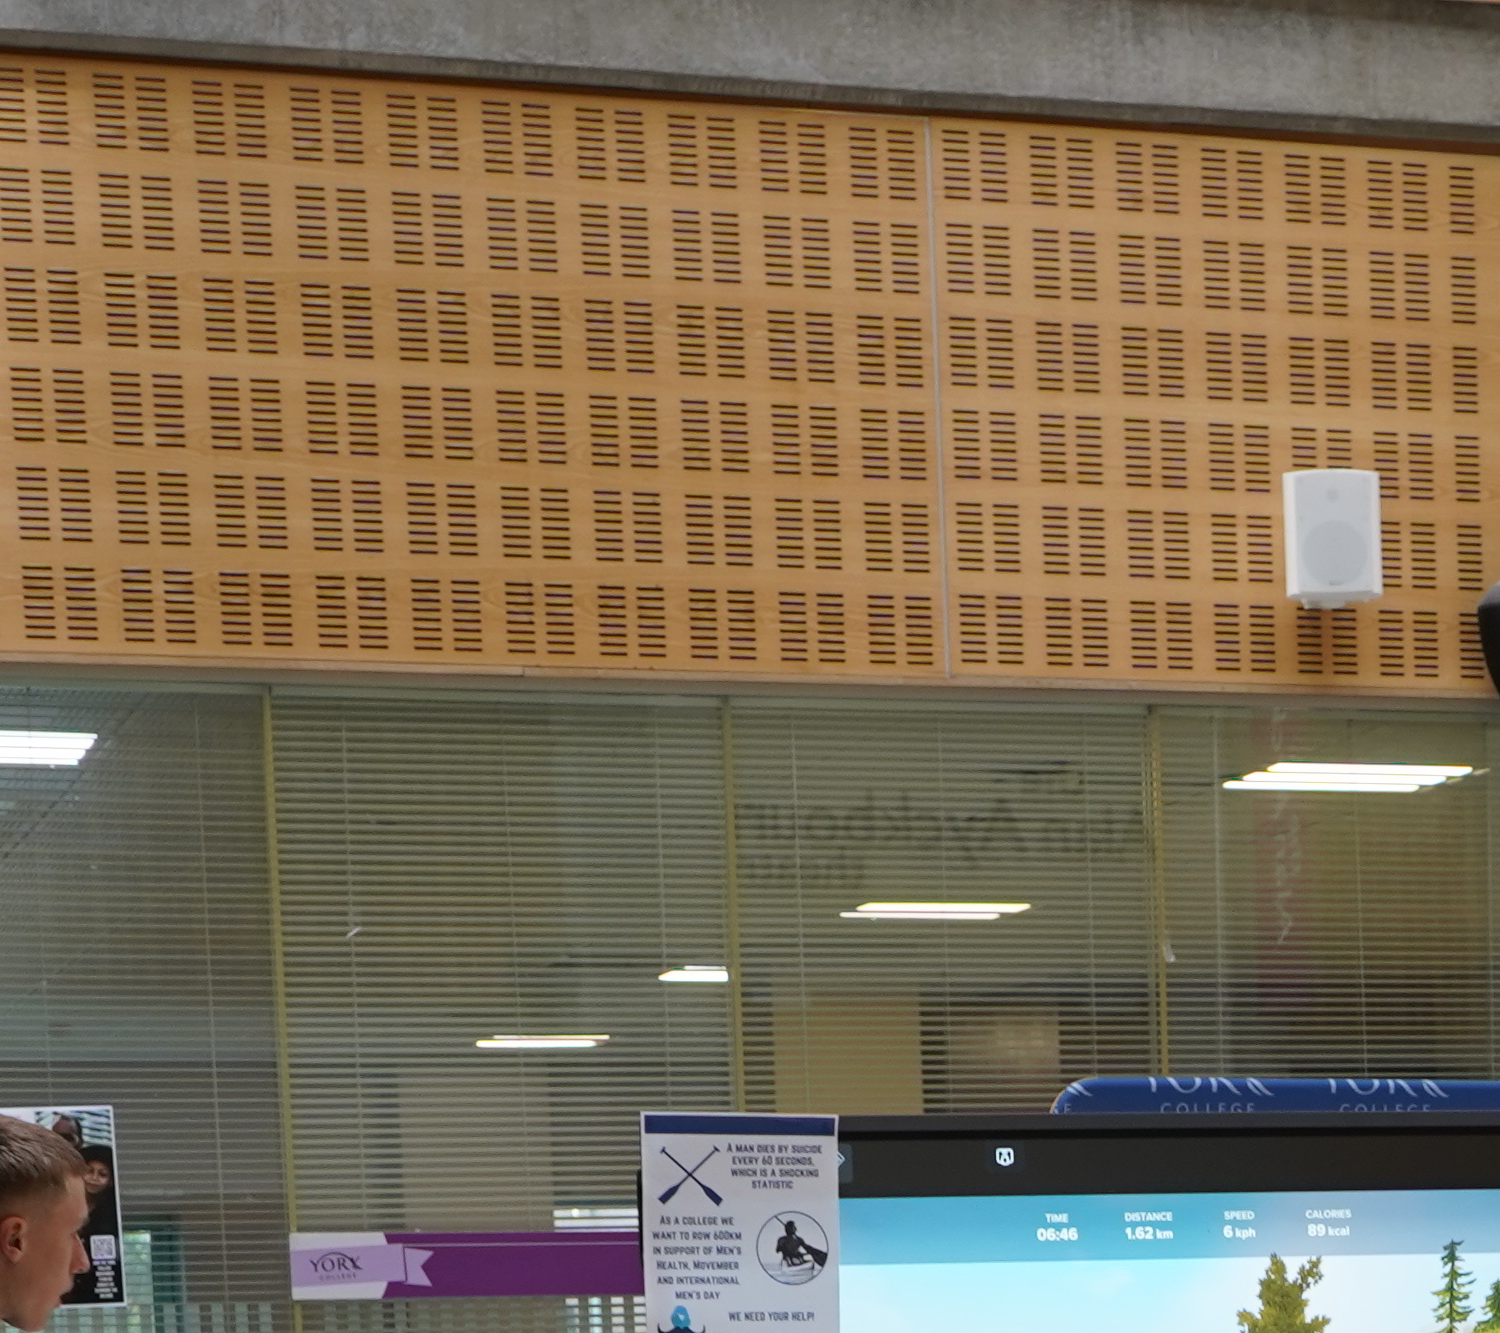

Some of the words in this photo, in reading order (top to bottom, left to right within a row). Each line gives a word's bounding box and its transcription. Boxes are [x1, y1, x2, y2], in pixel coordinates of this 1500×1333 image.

[727, 1143, 733, 1153] A
[735, 1144, 754, 1153] MAN
[757, 1145, 776, 1153] DIES
[778, 1145, 788, 1153] BY
[791, 1145, 822, 1154] SUICIDE
[732, 1157, 759, 1165] EVERY
[762, 1156, 773, 1165] 60
[731, 1168, 757, 1177] WHICH
[759, 1169, 768, 1177] IS
[770, 1169, 776, 1177] A
[778, 1169, 819, 1177] SHOCKING
[751, 1180, 793, 1189] STATISTIC
[1045, 1212, 1068, 1223] TIME
[1124, 1211, 1173, 1222] DISTANCE
[1223, 1210, 1255, 1221] SPEED
[1305, 1208, 1352, 1220] CALORIES
[673, 1217, 680, 1225] A
[682, 1217, 718, 1225] COLLEGE
[720, 1217, 734, 1225] WE
[652, 1232, 676, 1240] WANT
[679, 1232, 690, 1240] TO
[692, 1232, 711, 1240] ROW
[1036, 1227, 1078, 1242] 06:46
[1125, 1226, 1154, 1240] 1.62
[1155, 1228, 1174, 1240] km
[1223, 1225, 1233, 1239] 6
[1235, 1225, 1256, 1241] kph
[1307, 1223, 1326, 1238] 89
[1328, 1223, 1350, 1238] kcal
[653, 1247, 662, 1255] IN
[664, 1246, 701, 1255] SUPPORT
[703, 1247, 713, 1255] OF
[309, 1252, 363, 1272] YORK
[657, 1276, 674, 1285] AND
[676, 1276, 740, 1285] INTERNATIONAL
[675, 1291, 701, 1300] MEN'S
[704, 1291, 720, 1300] DAY
[728, 1312, 741, 1322] WE
[744, 1312, 765, 1322] NEED
[768, 1312, 789, 1322] YOUR
[791, 1312, 815, 1322] HELP!
